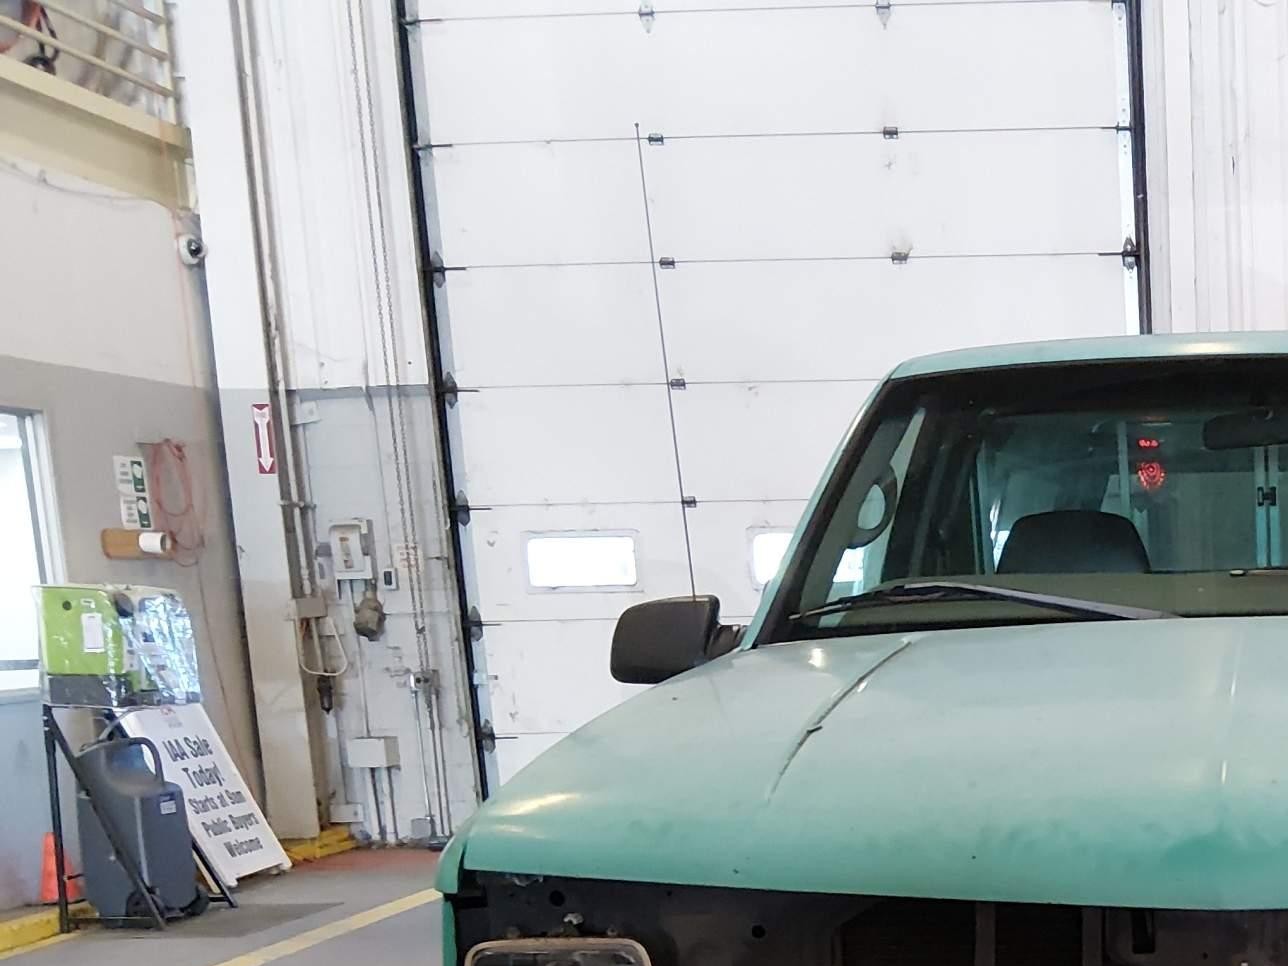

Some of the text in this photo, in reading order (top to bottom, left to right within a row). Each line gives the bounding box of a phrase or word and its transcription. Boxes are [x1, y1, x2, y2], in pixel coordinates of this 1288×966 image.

[163, 734, 214, 762] IAA Sale
[182, 762, 226, 788] Today!
[188, 795, 219, 815] Starts
[217, 792, 229, 808] at
[201, 816, 232, 838] Public
[223, 836, 264, 858] Welcome
